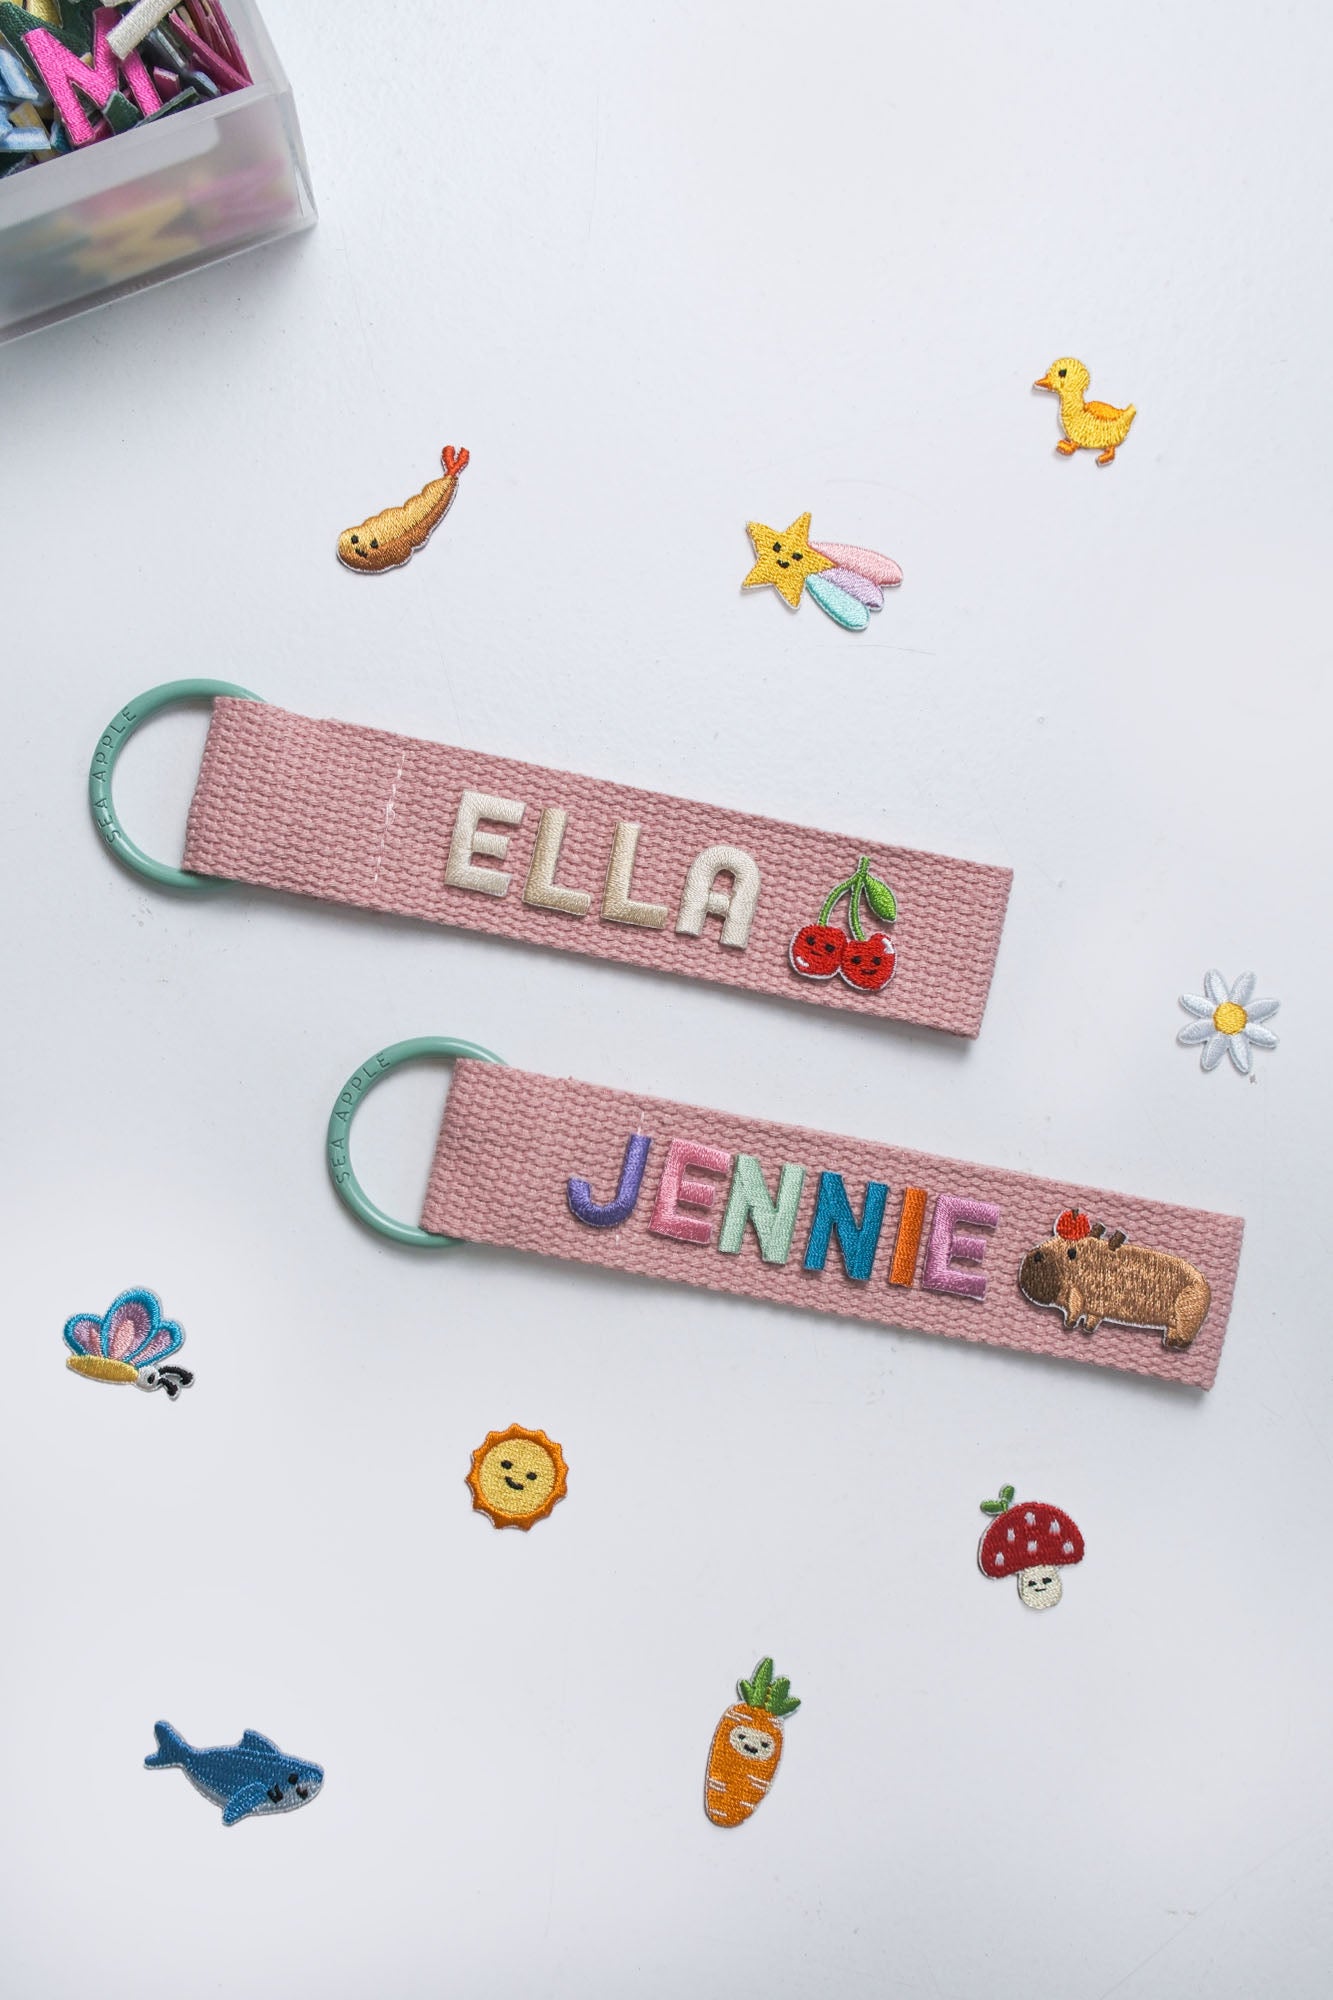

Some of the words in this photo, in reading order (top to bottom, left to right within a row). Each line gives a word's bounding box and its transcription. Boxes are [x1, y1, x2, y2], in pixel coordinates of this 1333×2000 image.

[22, 6, 164, 146] M
[92, 705, 137, 783] APPLE
[93, 796, 122, 844] SEA
[444, 790, 761, 950] ELLA
[335, 1051, 391, 1123] APPLE
[331, 1136, 351, 1185] SEA
[567, 1133, 1000, 1301] JENNIE
